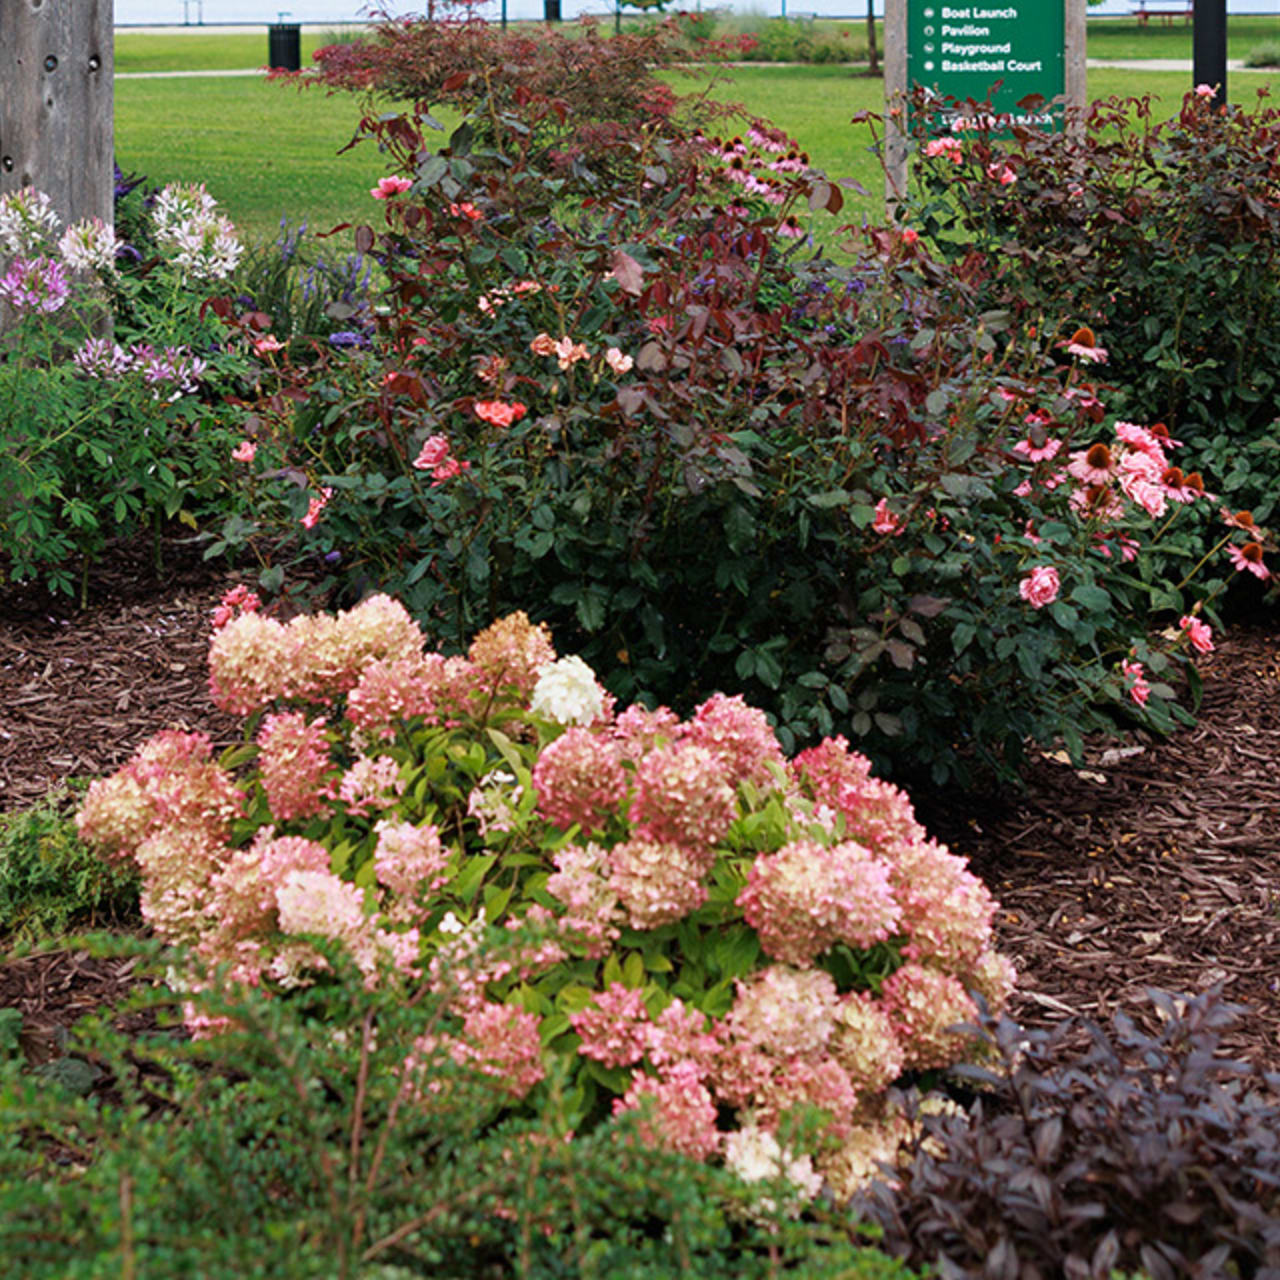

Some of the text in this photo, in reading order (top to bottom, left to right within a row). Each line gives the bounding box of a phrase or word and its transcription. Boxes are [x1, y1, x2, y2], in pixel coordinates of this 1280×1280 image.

[941, 7, 1017, 18] Boat Launch
[941, 25, 989, 36] Pavilion
[941, 43, 1010, 56] Playground
[941, 60, 1042, 71] Basketball Court
